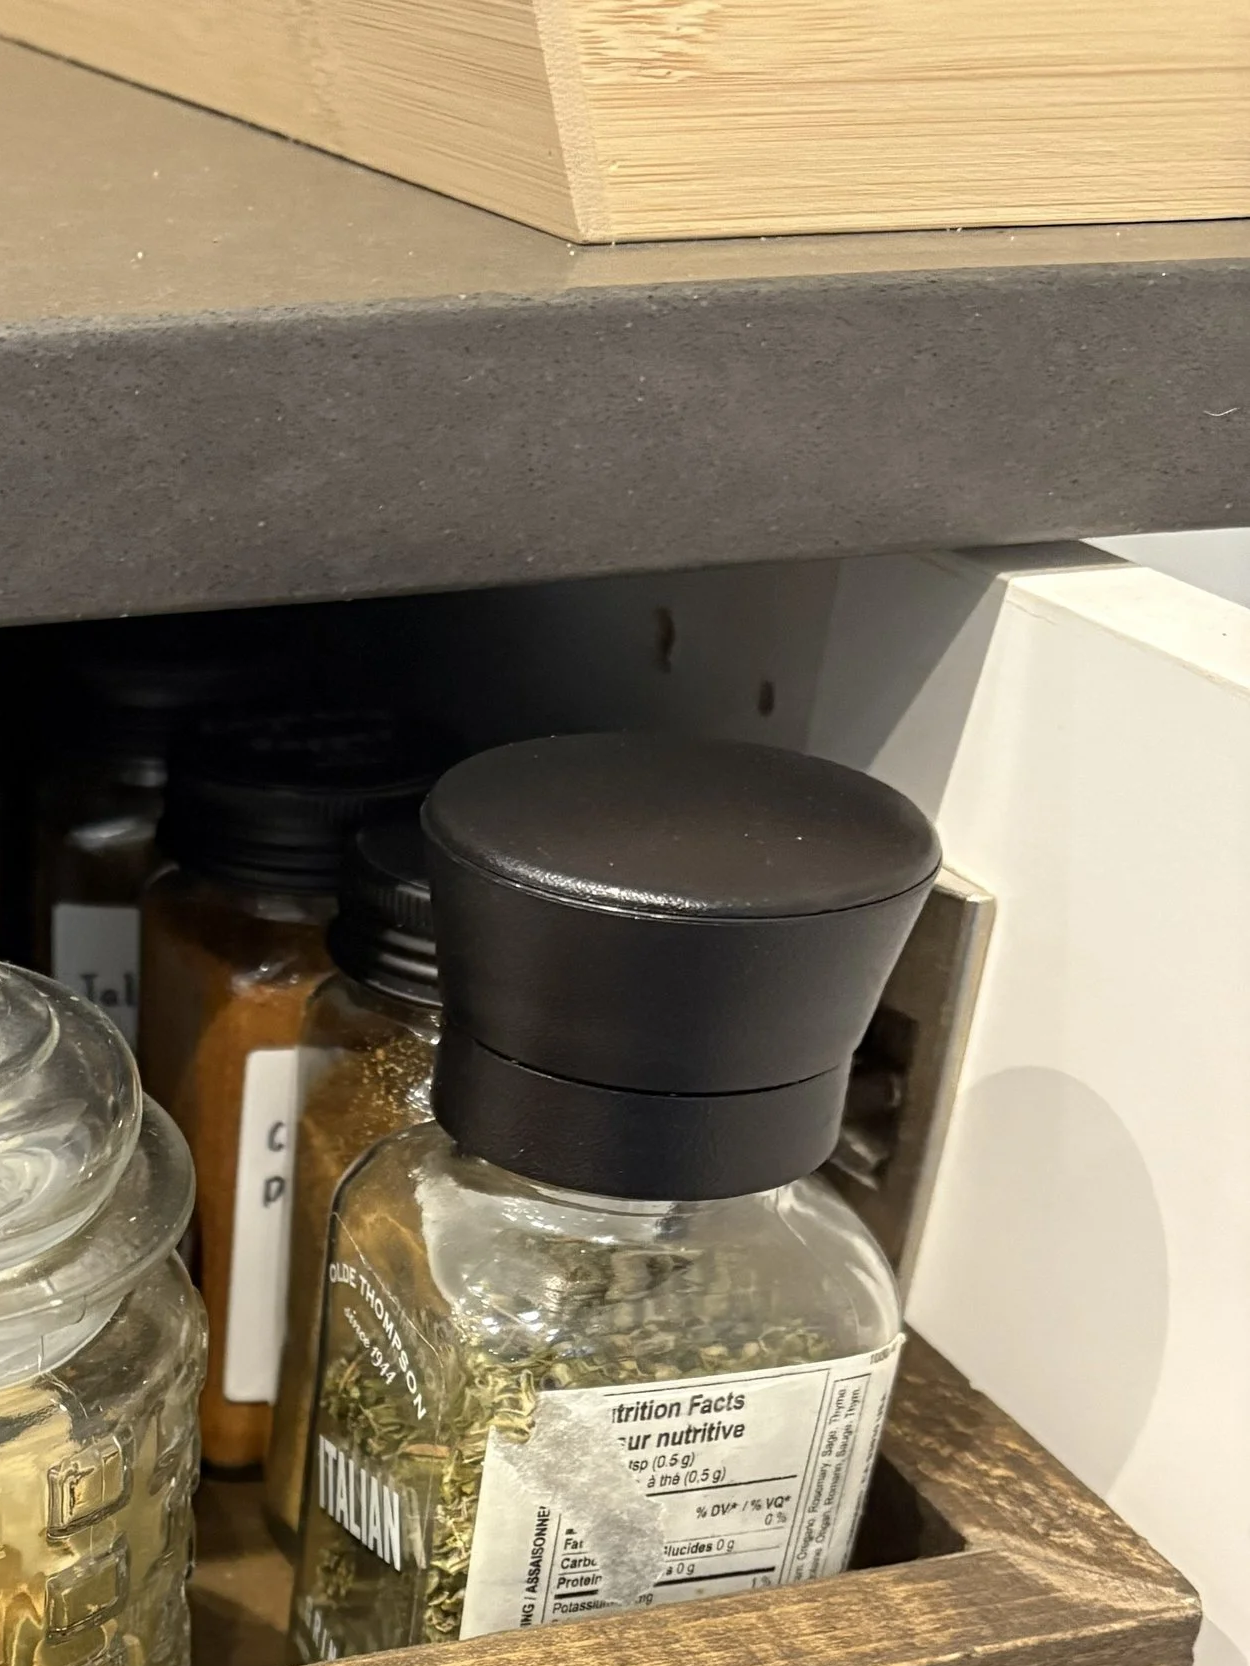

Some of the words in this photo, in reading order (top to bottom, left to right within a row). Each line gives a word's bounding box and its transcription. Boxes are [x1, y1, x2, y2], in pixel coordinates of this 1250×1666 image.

[329, 1263, 357, 1288] OLDE
[358, 1274, 427, 1421] THOMPSON
[370, 1346, 397, 1385] 1944
[687, 1392, 746, 1417] Facts
[656, 1420, 747, 1449] nutritive
[681, 1452, 695, 1469] g)
[660, 1471, 681, 1488] thé
[712, 1466, 727, 1484] g)
[318, 1434, 401, 1572] ITALIAN
[526, 1506, 551, 1593] ASSAISONNE
[564, 1538, 584, 1551] Fat
